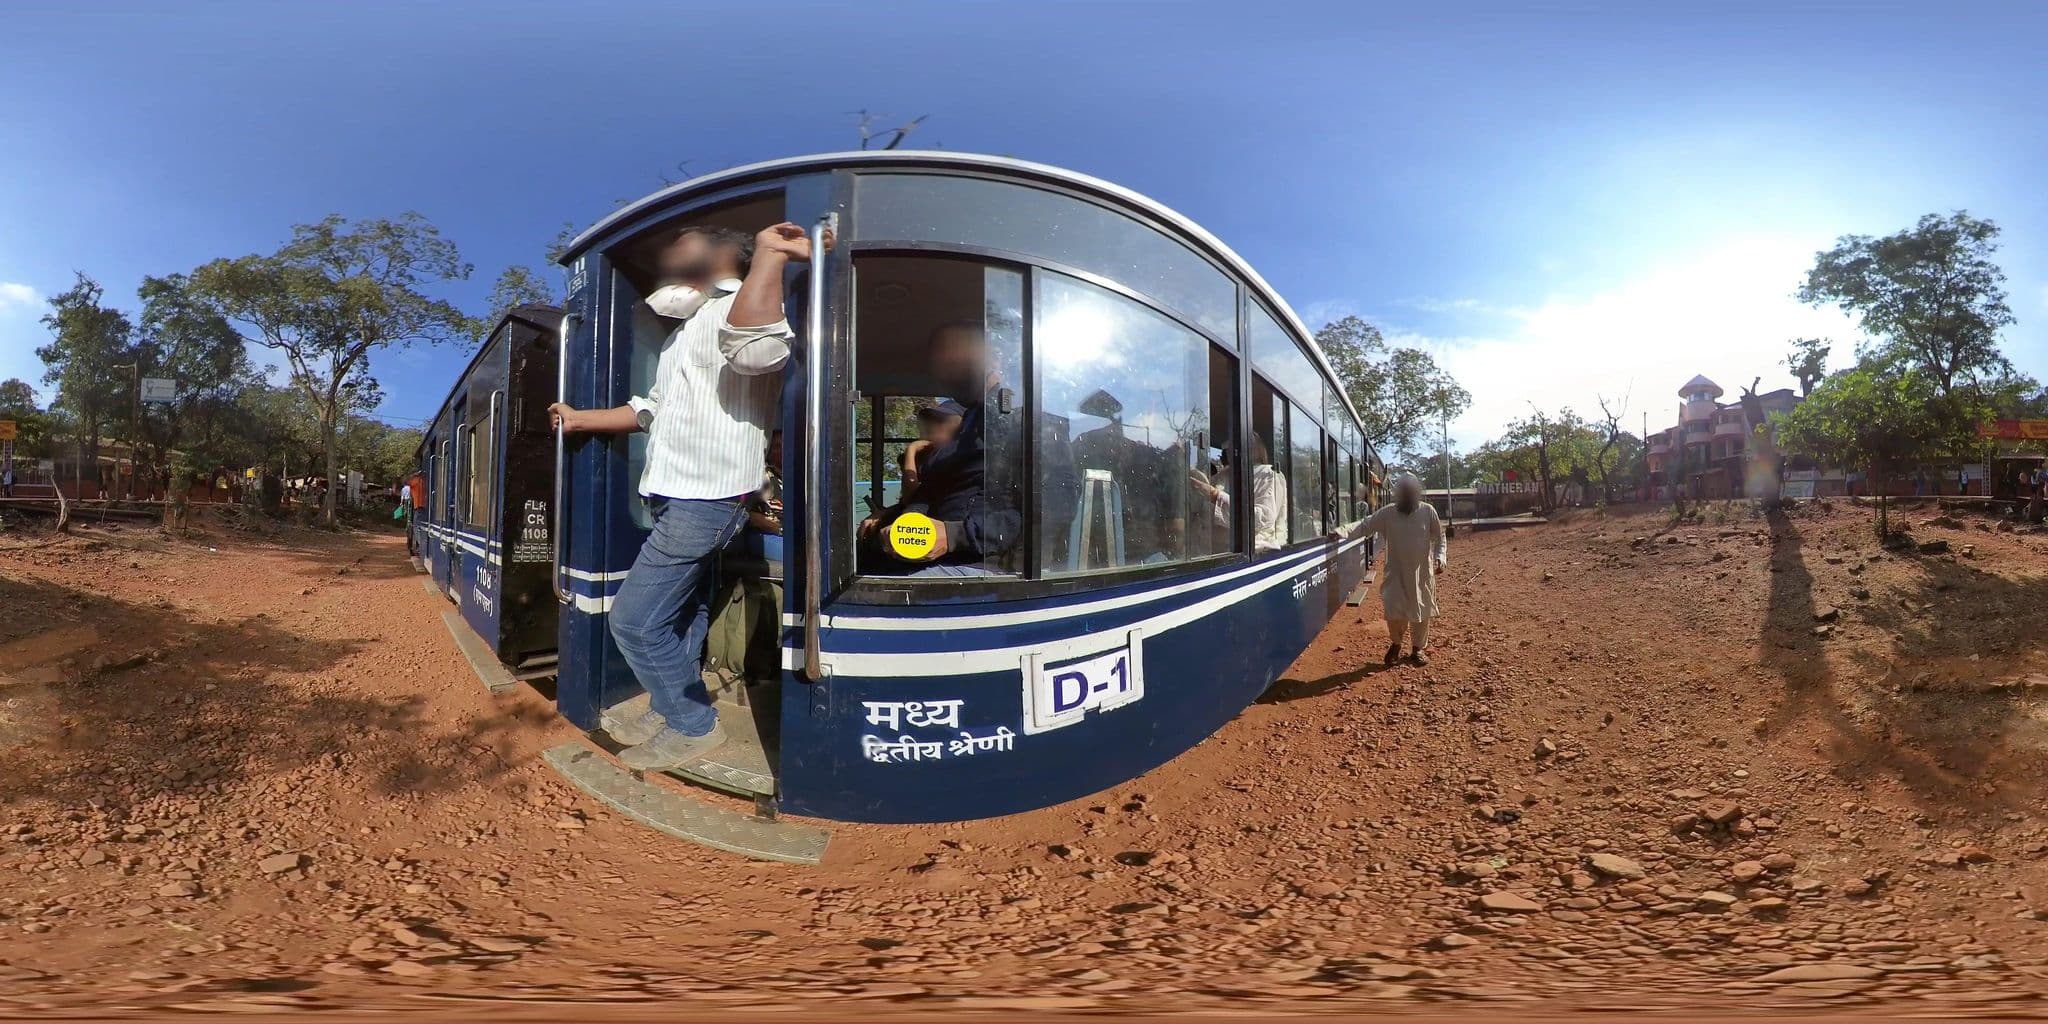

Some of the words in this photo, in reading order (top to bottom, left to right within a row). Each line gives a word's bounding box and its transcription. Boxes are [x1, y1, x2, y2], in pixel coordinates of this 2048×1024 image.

[1478, 481, 1539, 494] MATHERAN
[527, 513, 545, 525] CR
[522, 527, 548, 540] 1108
[476, 564, 492, 590] 1108
[1292, 577, 1307, 599] नेरल
[1053, 656, 1127, 713] D-1
[861, 699, 964, 731] मध्य
[861, 734, 944, 763] द्वितीय
[948, 726, 1016, 756] श्रेणी
